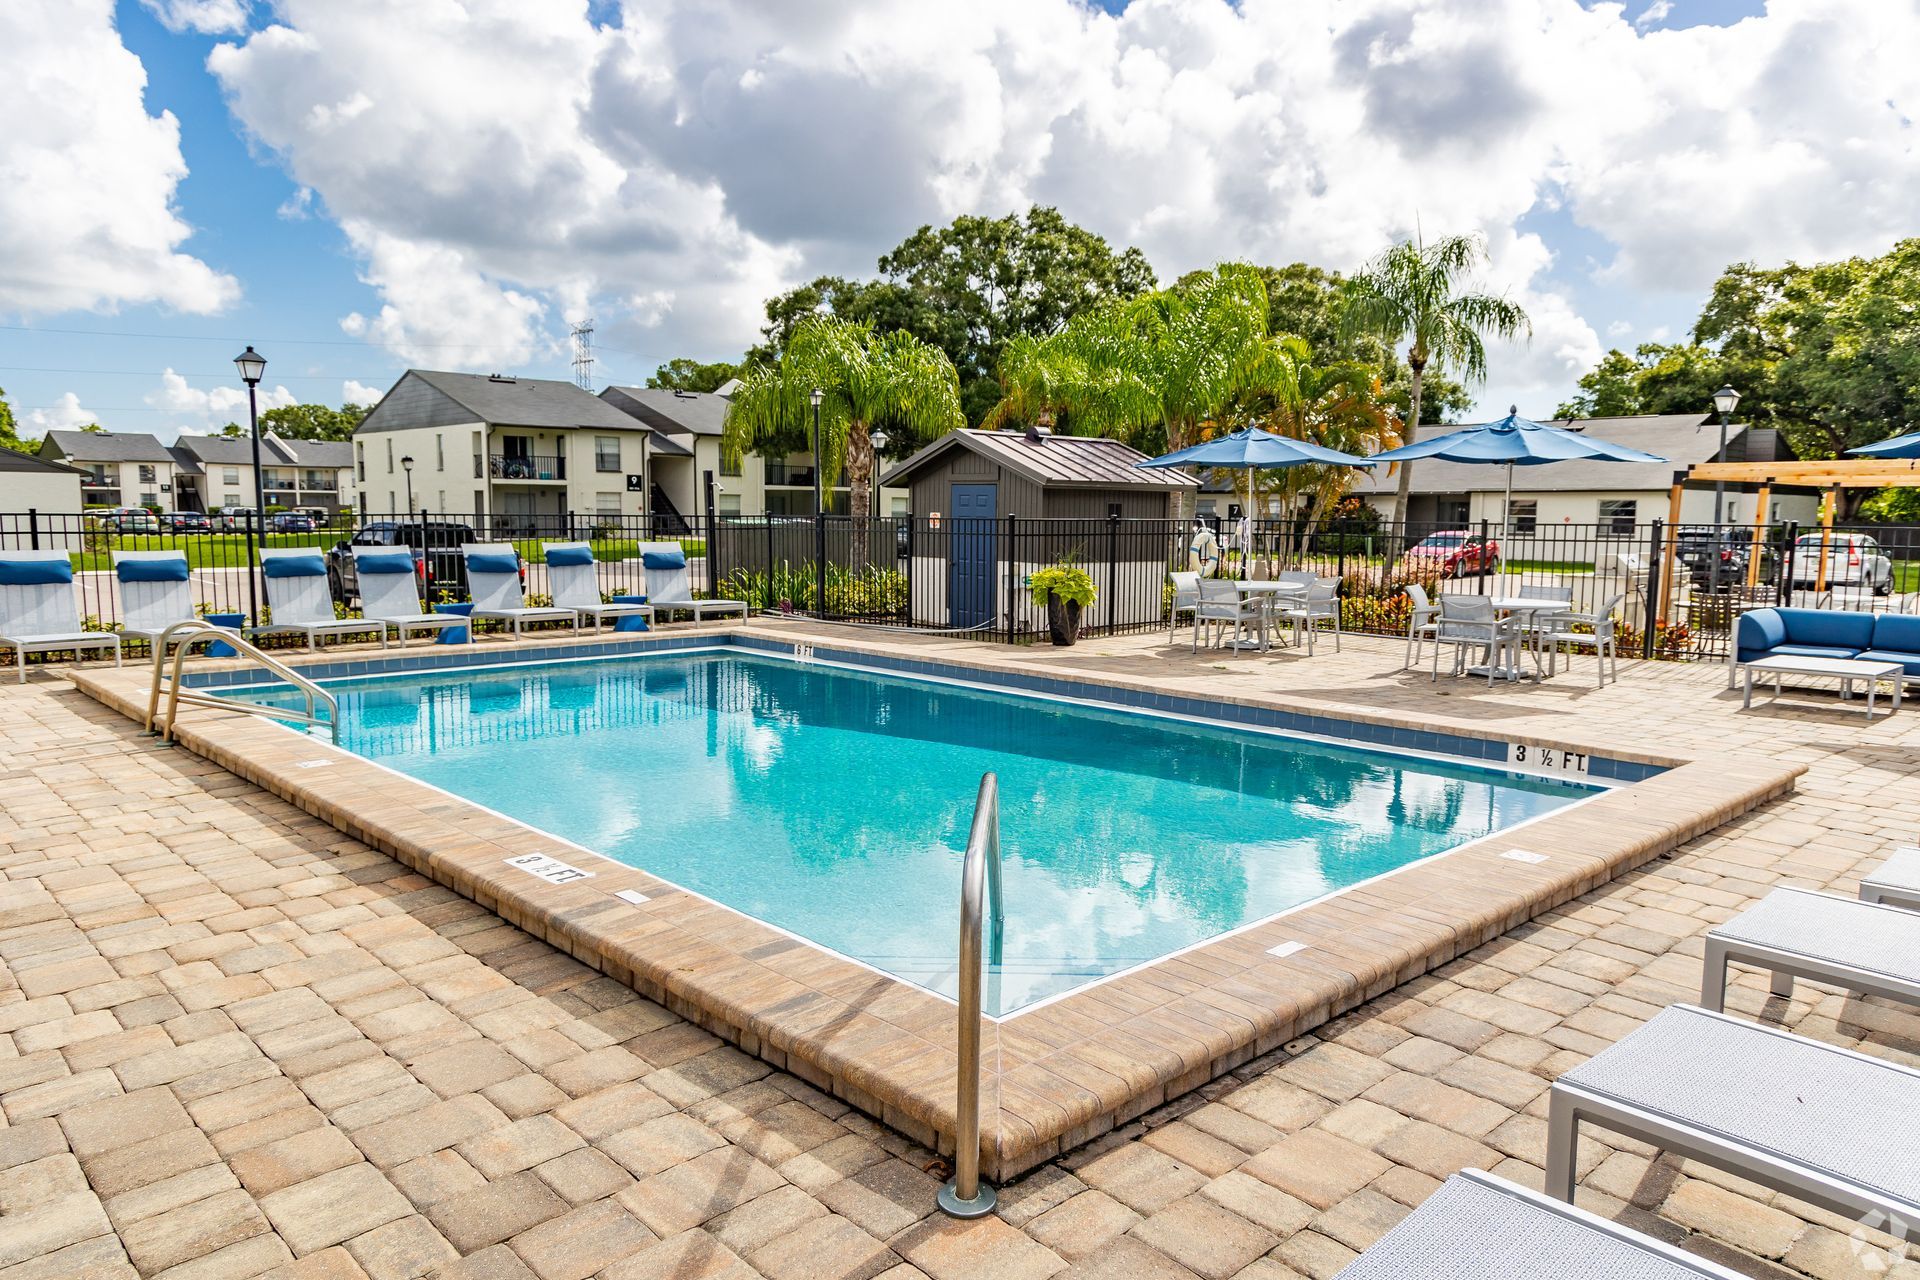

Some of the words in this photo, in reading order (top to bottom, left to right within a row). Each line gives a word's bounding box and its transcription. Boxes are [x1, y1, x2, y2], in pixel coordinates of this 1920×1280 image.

[631, 476, 638, 485] 9
[1233, 506, 1239, 515] 7
[796, 644, 802, 655] 6
[1515, 744, 1527, 762] 3
[1562, 751, 1586, 772] FT.
[515, 856, 543, 864] 3
